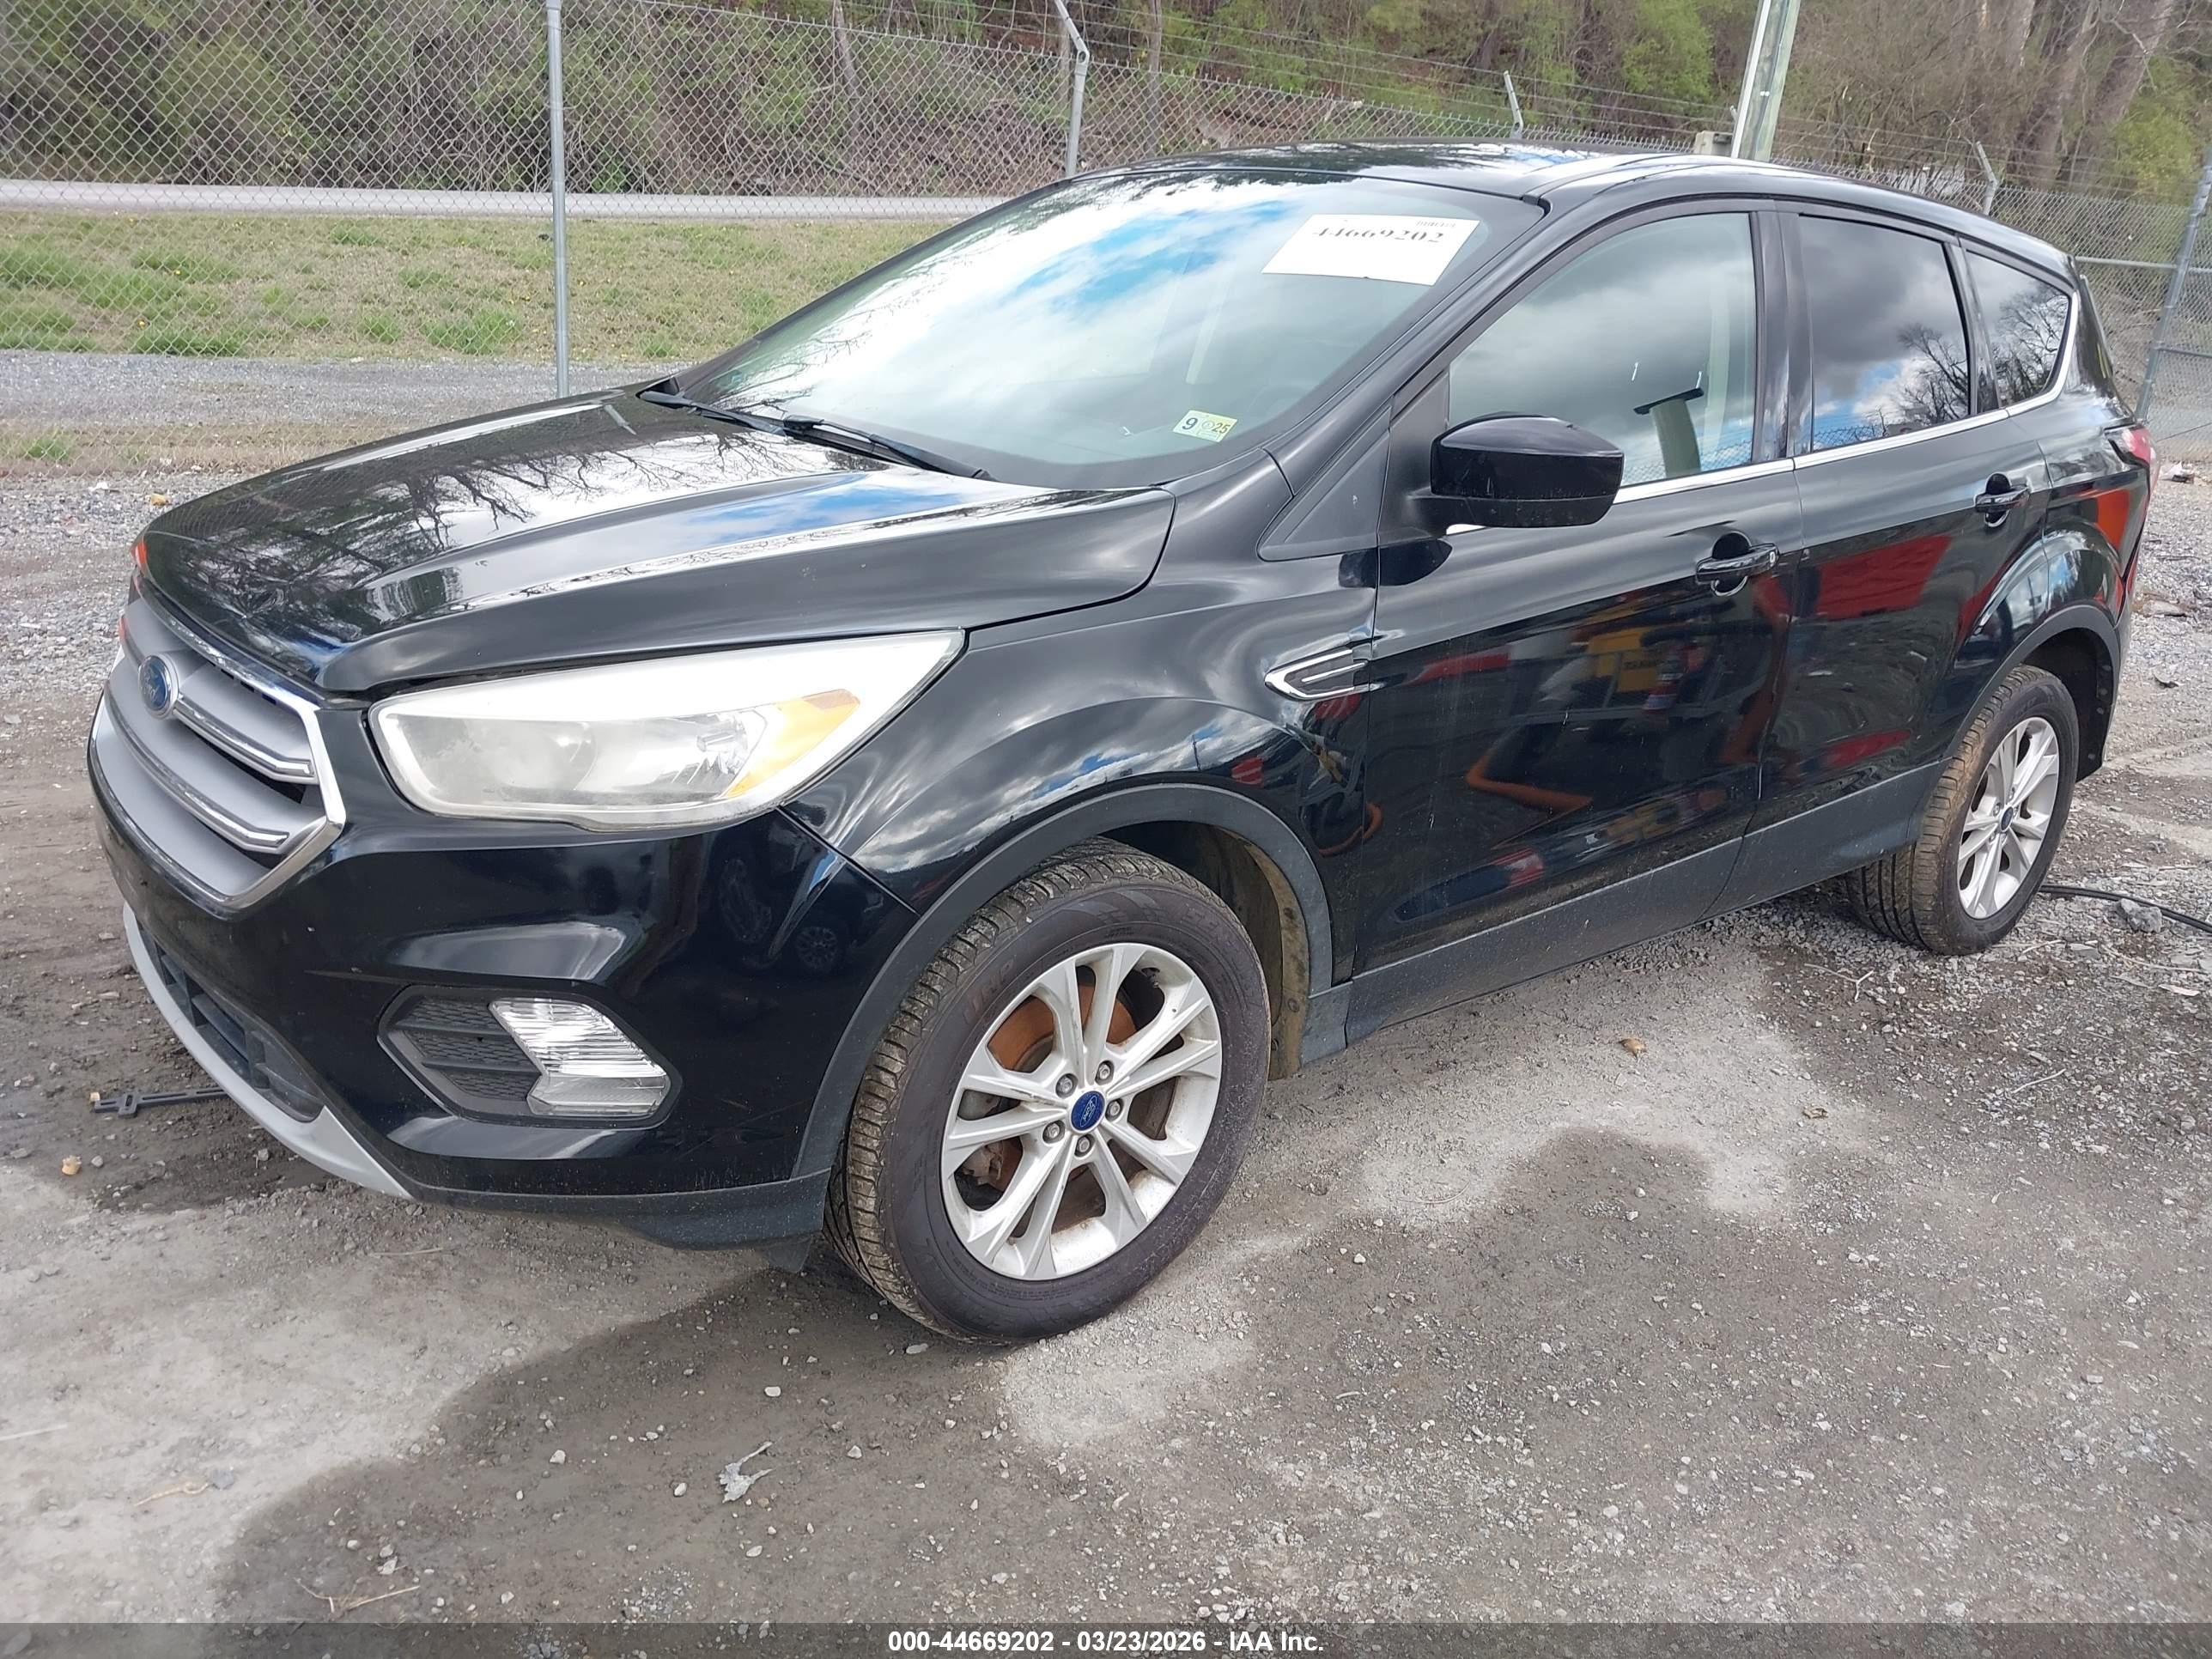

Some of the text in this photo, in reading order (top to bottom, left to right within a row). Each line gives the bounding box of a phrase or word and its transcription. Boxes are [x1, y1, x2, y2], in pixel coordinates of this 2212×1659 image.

[1313, 228, 1444, 242] 44669202
[1182, 417, 1231, 434] 9 25
